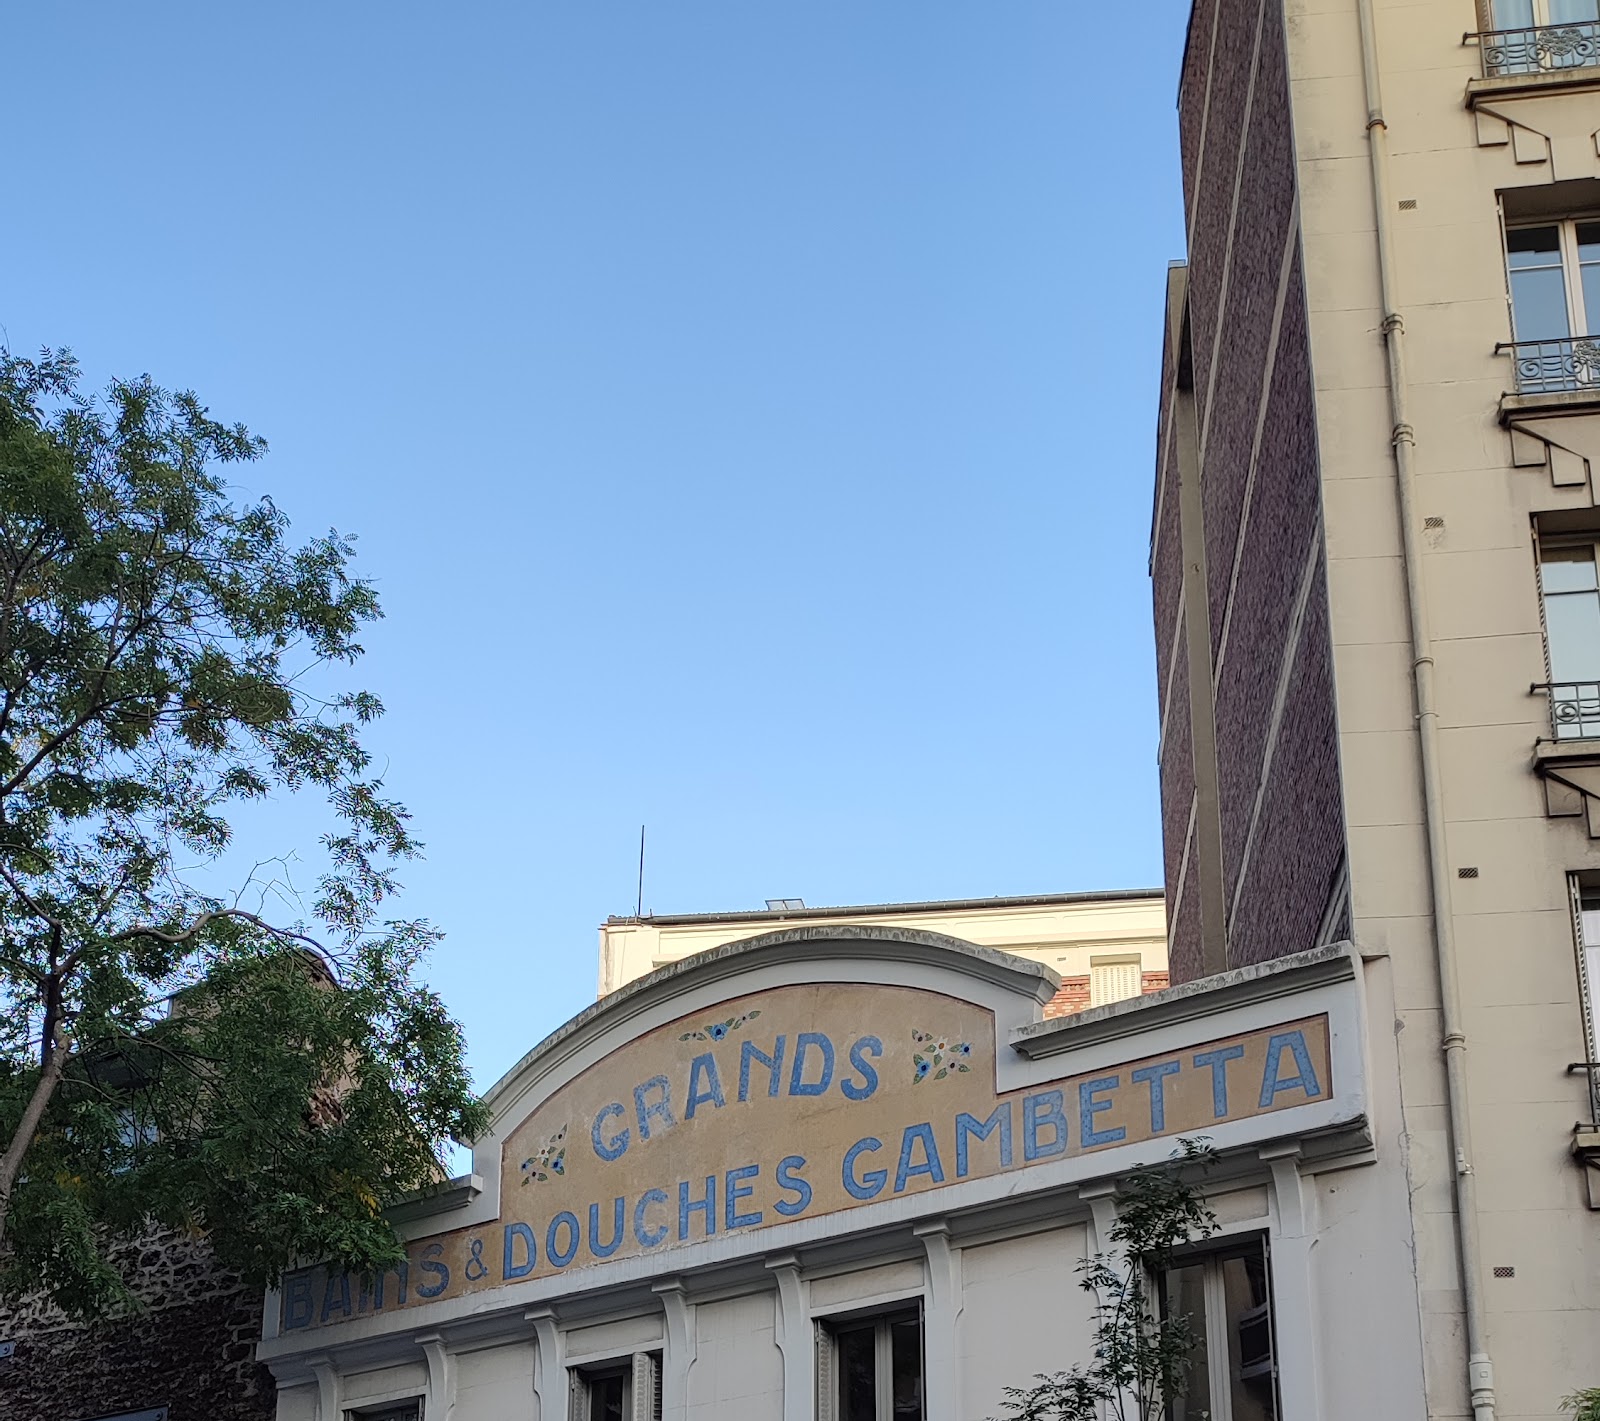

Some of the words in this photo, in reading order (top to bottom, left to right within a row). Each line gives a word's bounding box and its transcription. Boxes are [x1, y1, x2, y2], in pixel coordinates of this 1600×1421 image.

[465, 1238, 489, 1281] &
[503, 1155, 813, 1281] DOUCHES
[842, 1029, 1321, 1200] GAMBETTA
[590, 1032, 883, 1162] GRANDS
